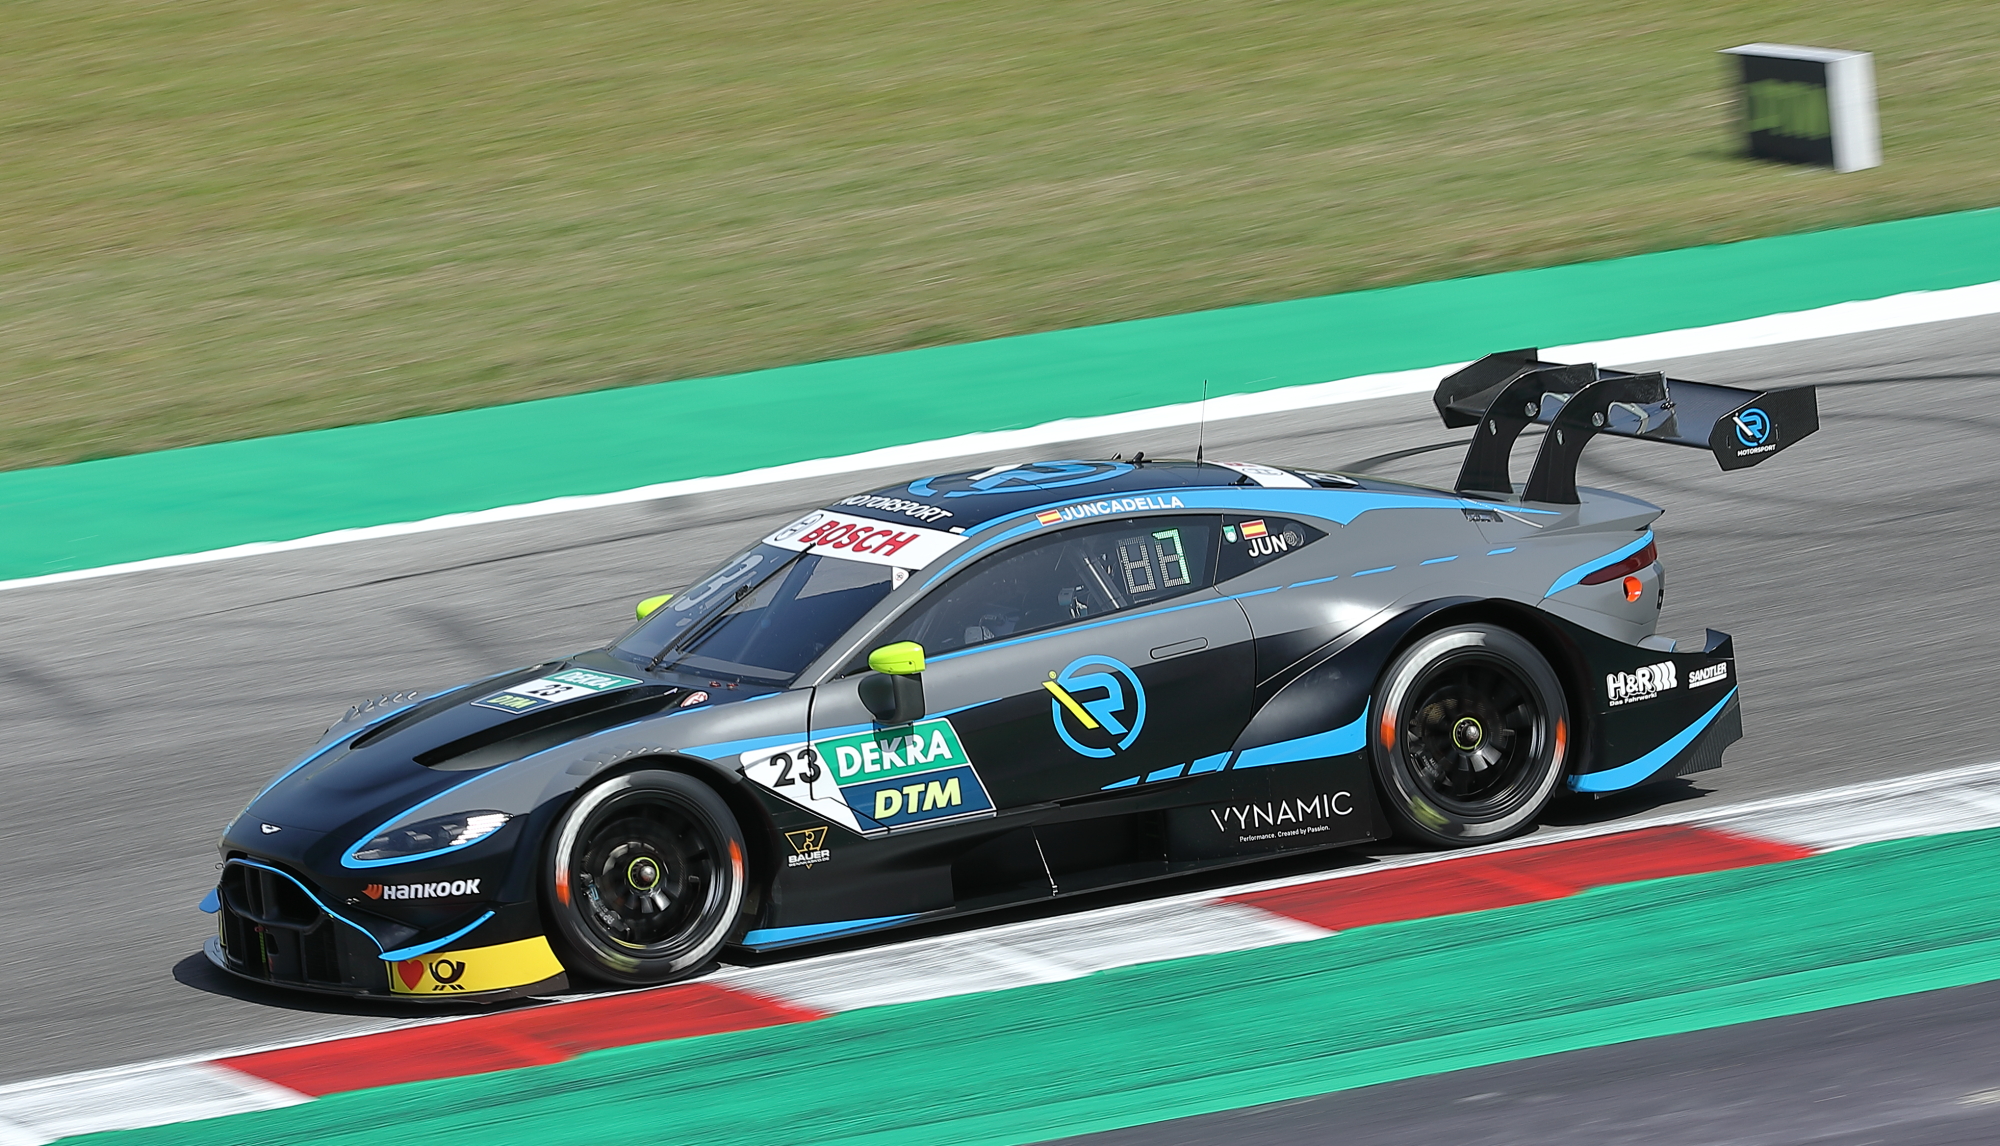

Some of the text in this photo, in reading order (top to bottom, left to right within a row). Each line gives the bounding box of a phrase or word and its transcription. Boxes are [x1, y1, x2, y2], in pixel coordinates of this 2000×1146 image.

[1737, 444, 1776, 457] MOTORSPORT
[1062, 496, 1185, 521] JUNCADELLA
[797, 520, 921, 557] BOSCH
[1248, 533, 1288, 557] JUN
[554, 671, 622, 689] DEKRA
[1689, 661, 1727, 683] SANDTLER
[486, 694, 538, 709] DTM
[526, 684, 574, 697] 23
[835, 729, 953, 778] DEKRA
[769, 749, 821, 788] 23
[874, 777, 962, 819] DTM
[1210, 791, 1353, 832] VYNAMIC
[1277, 828, 1299, 838] Created
[788, 849, 830, 863] BAUER
